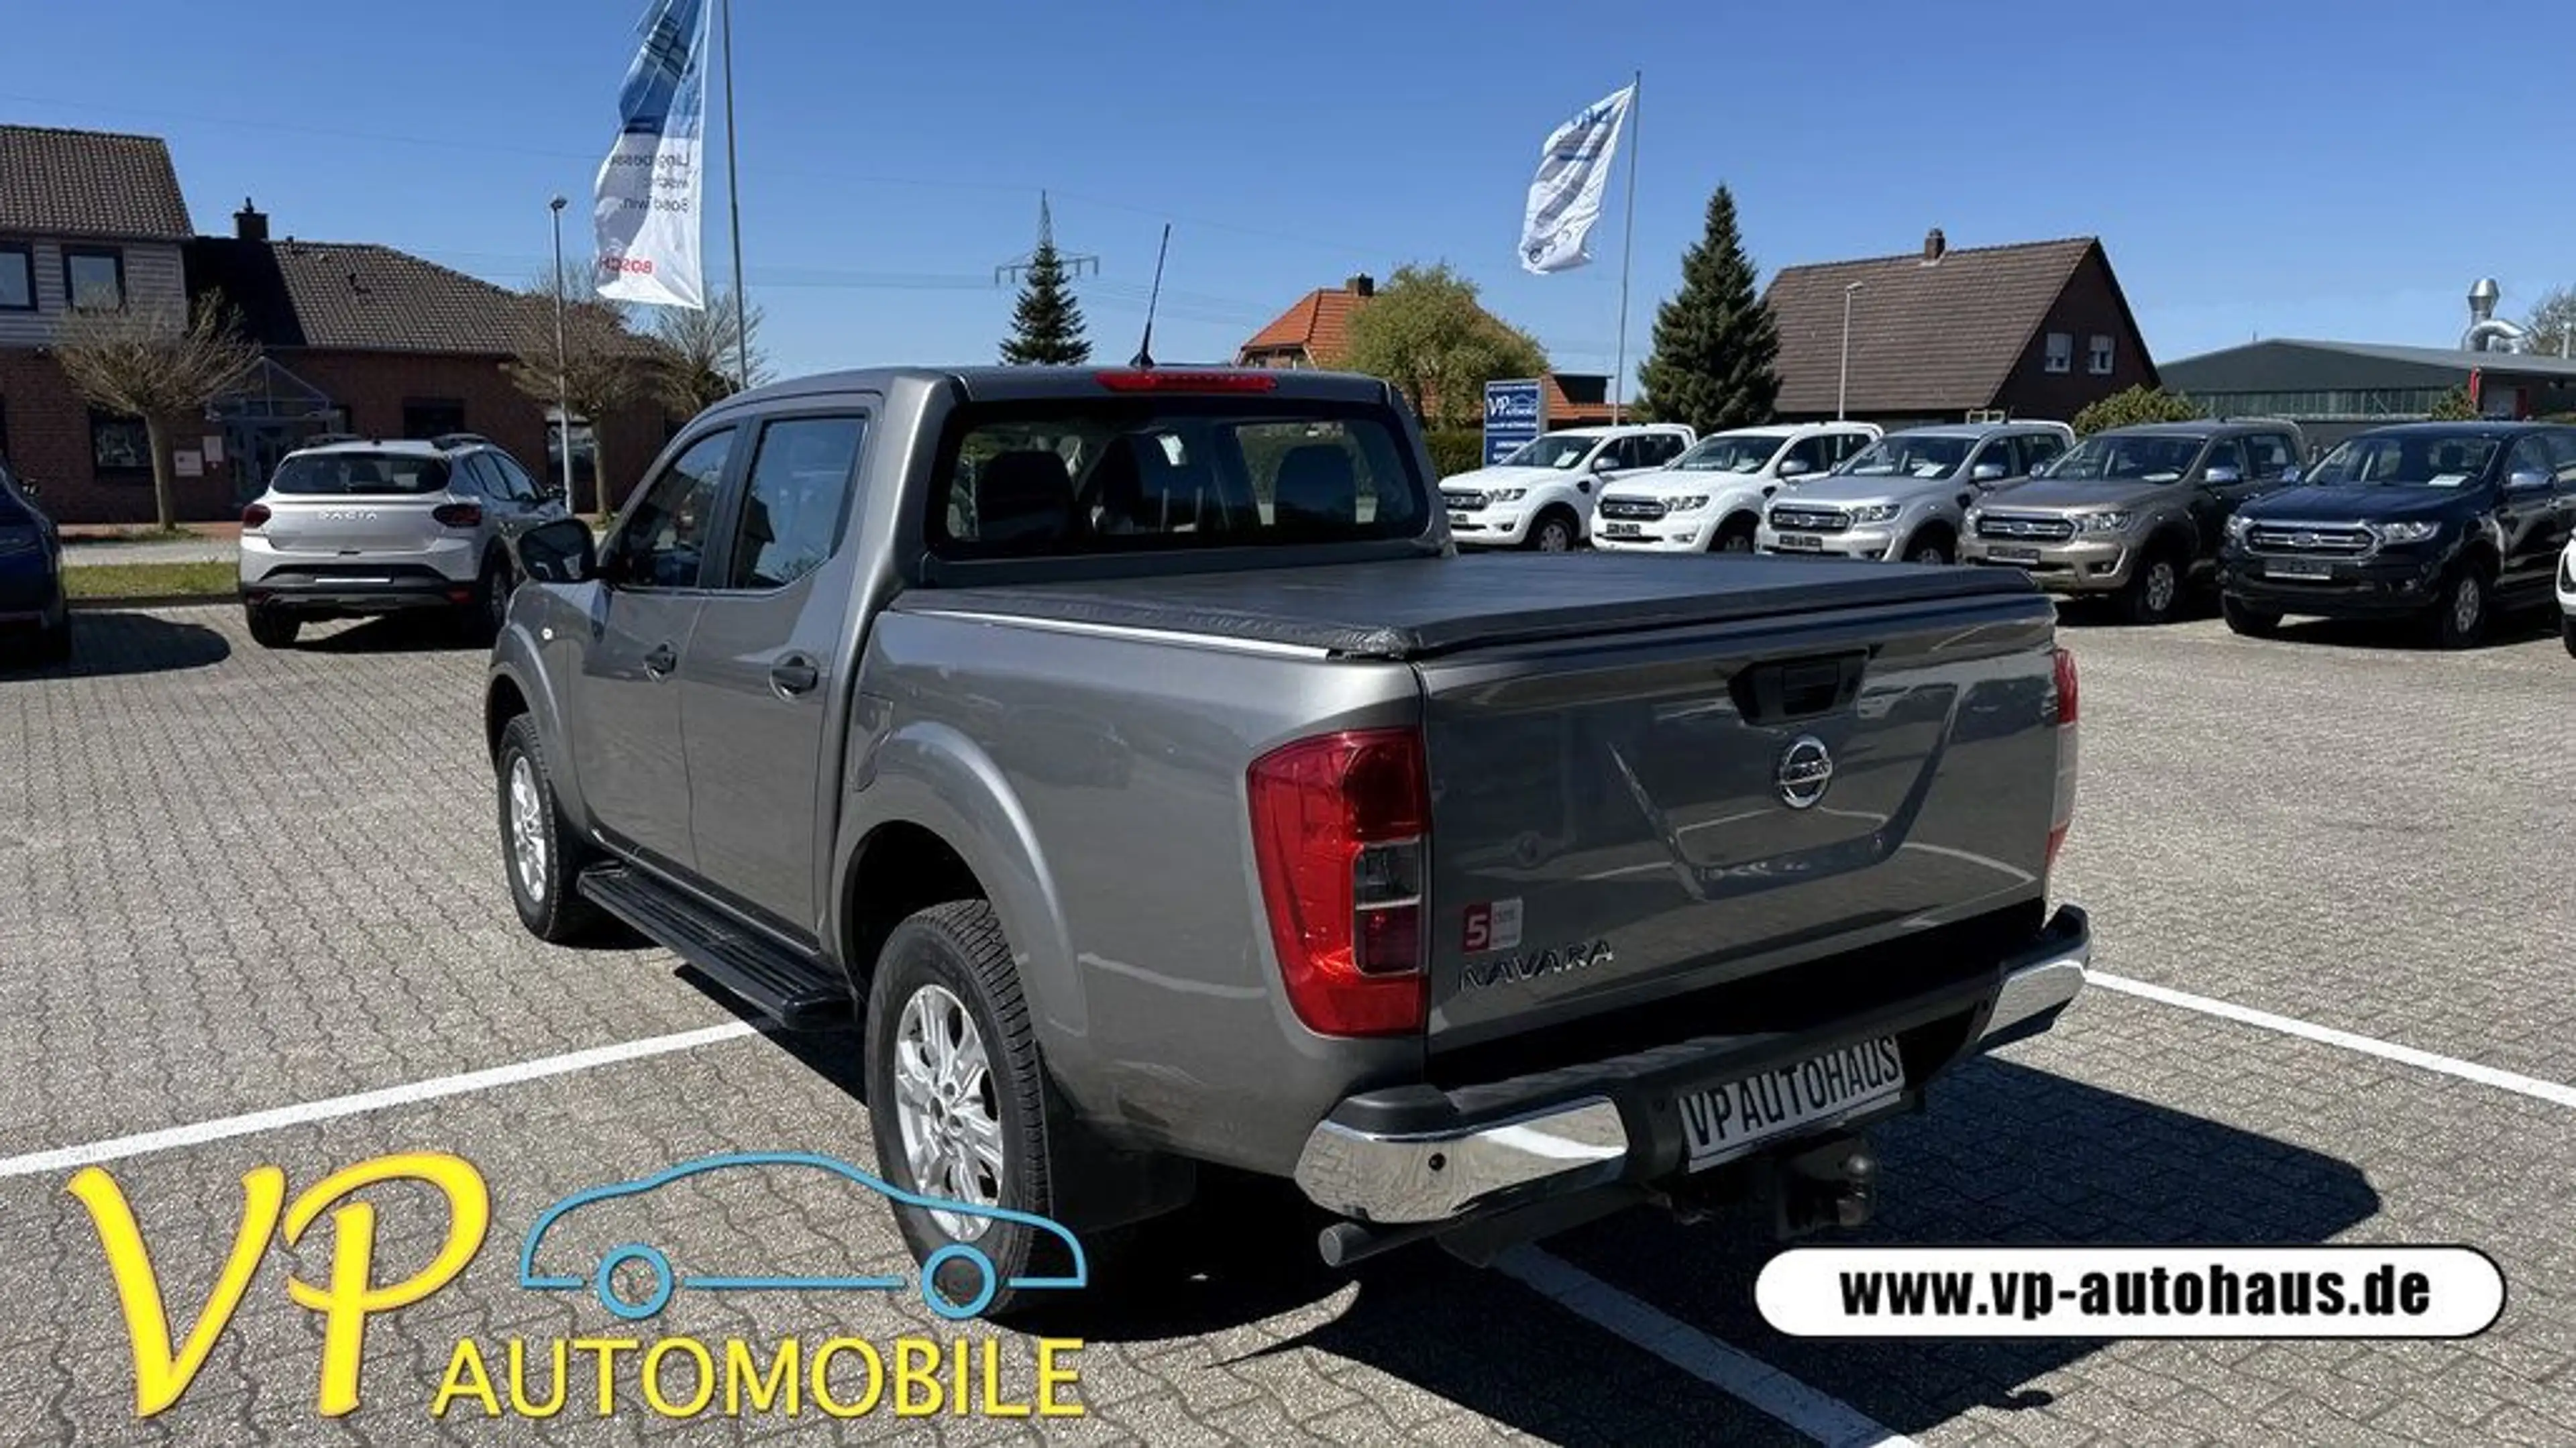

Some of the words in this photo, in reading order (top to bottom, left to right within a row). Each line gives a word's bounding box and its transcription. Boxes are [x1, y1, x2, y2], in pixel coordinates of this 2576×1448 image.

[318, 508, 378, 522] DACIA
[1458, 938, 1615, 993] NAVARA
[1684, 1084, 1733, 1147] VP
[1739, 1036, 1900, 1132] AUTOHAUS
